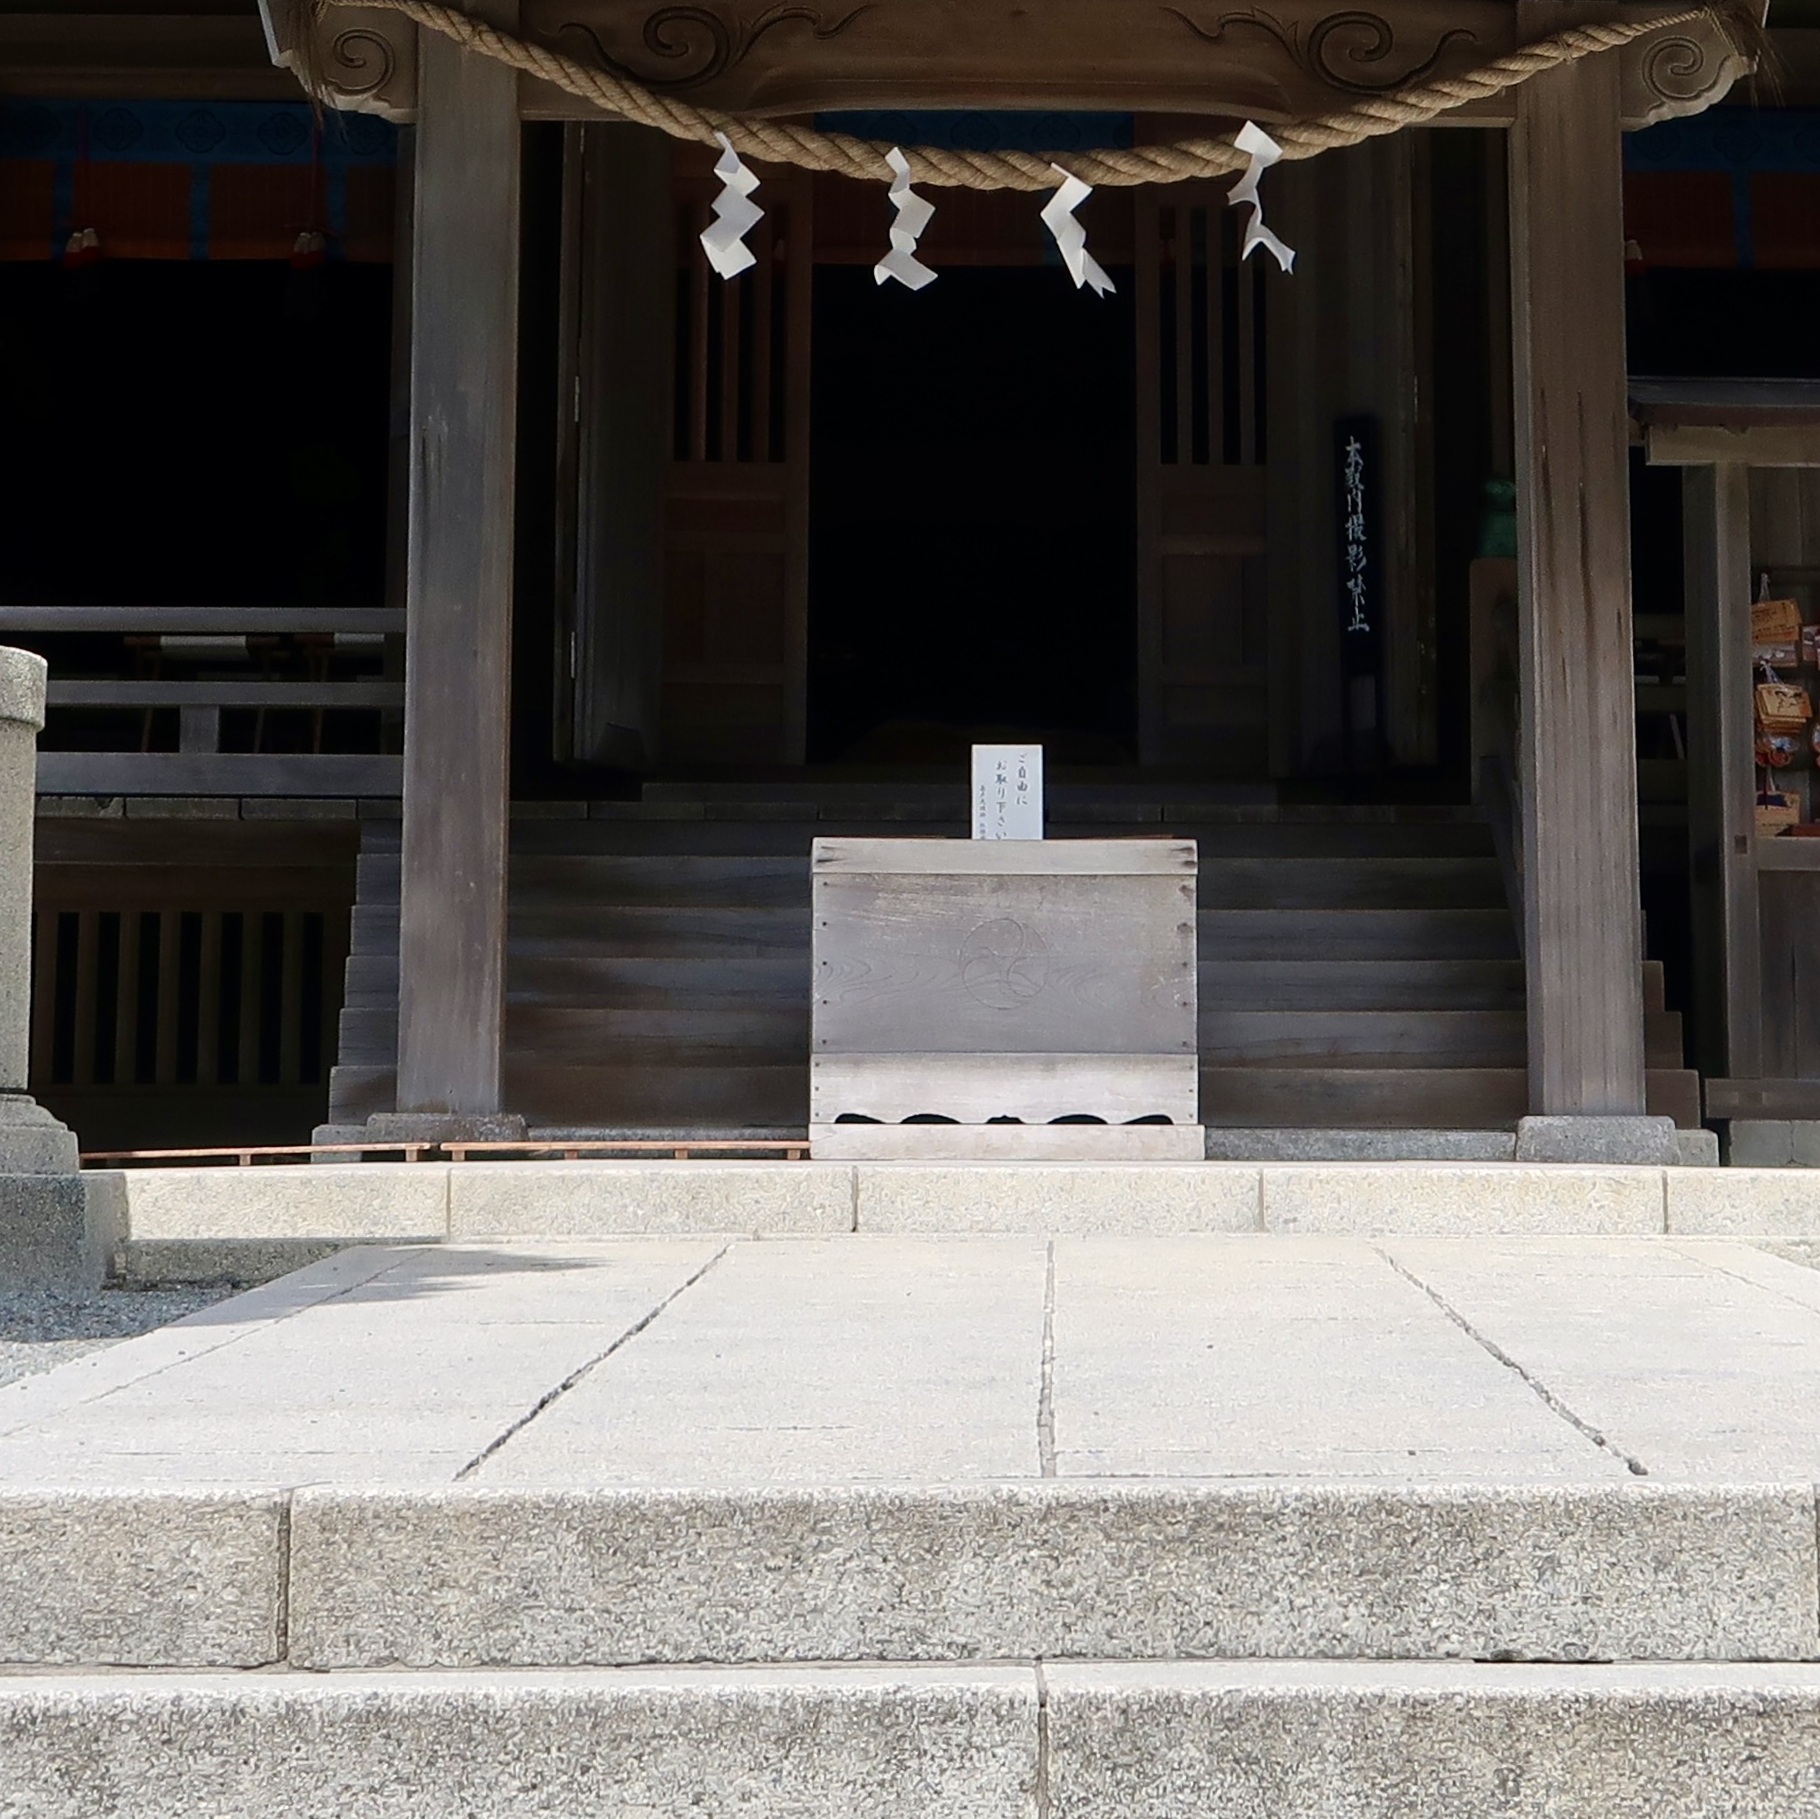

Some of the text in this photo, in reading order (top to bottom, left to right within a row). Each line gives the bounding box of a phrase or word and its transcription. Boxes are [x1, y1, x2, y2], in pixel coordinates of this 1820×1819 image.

[1345, 436, 1370, 631] 本殿内撮影禁止
[995, 760, 1008, 840] お取り下さい
[1016, 752, 1028, 805] ご自由に
